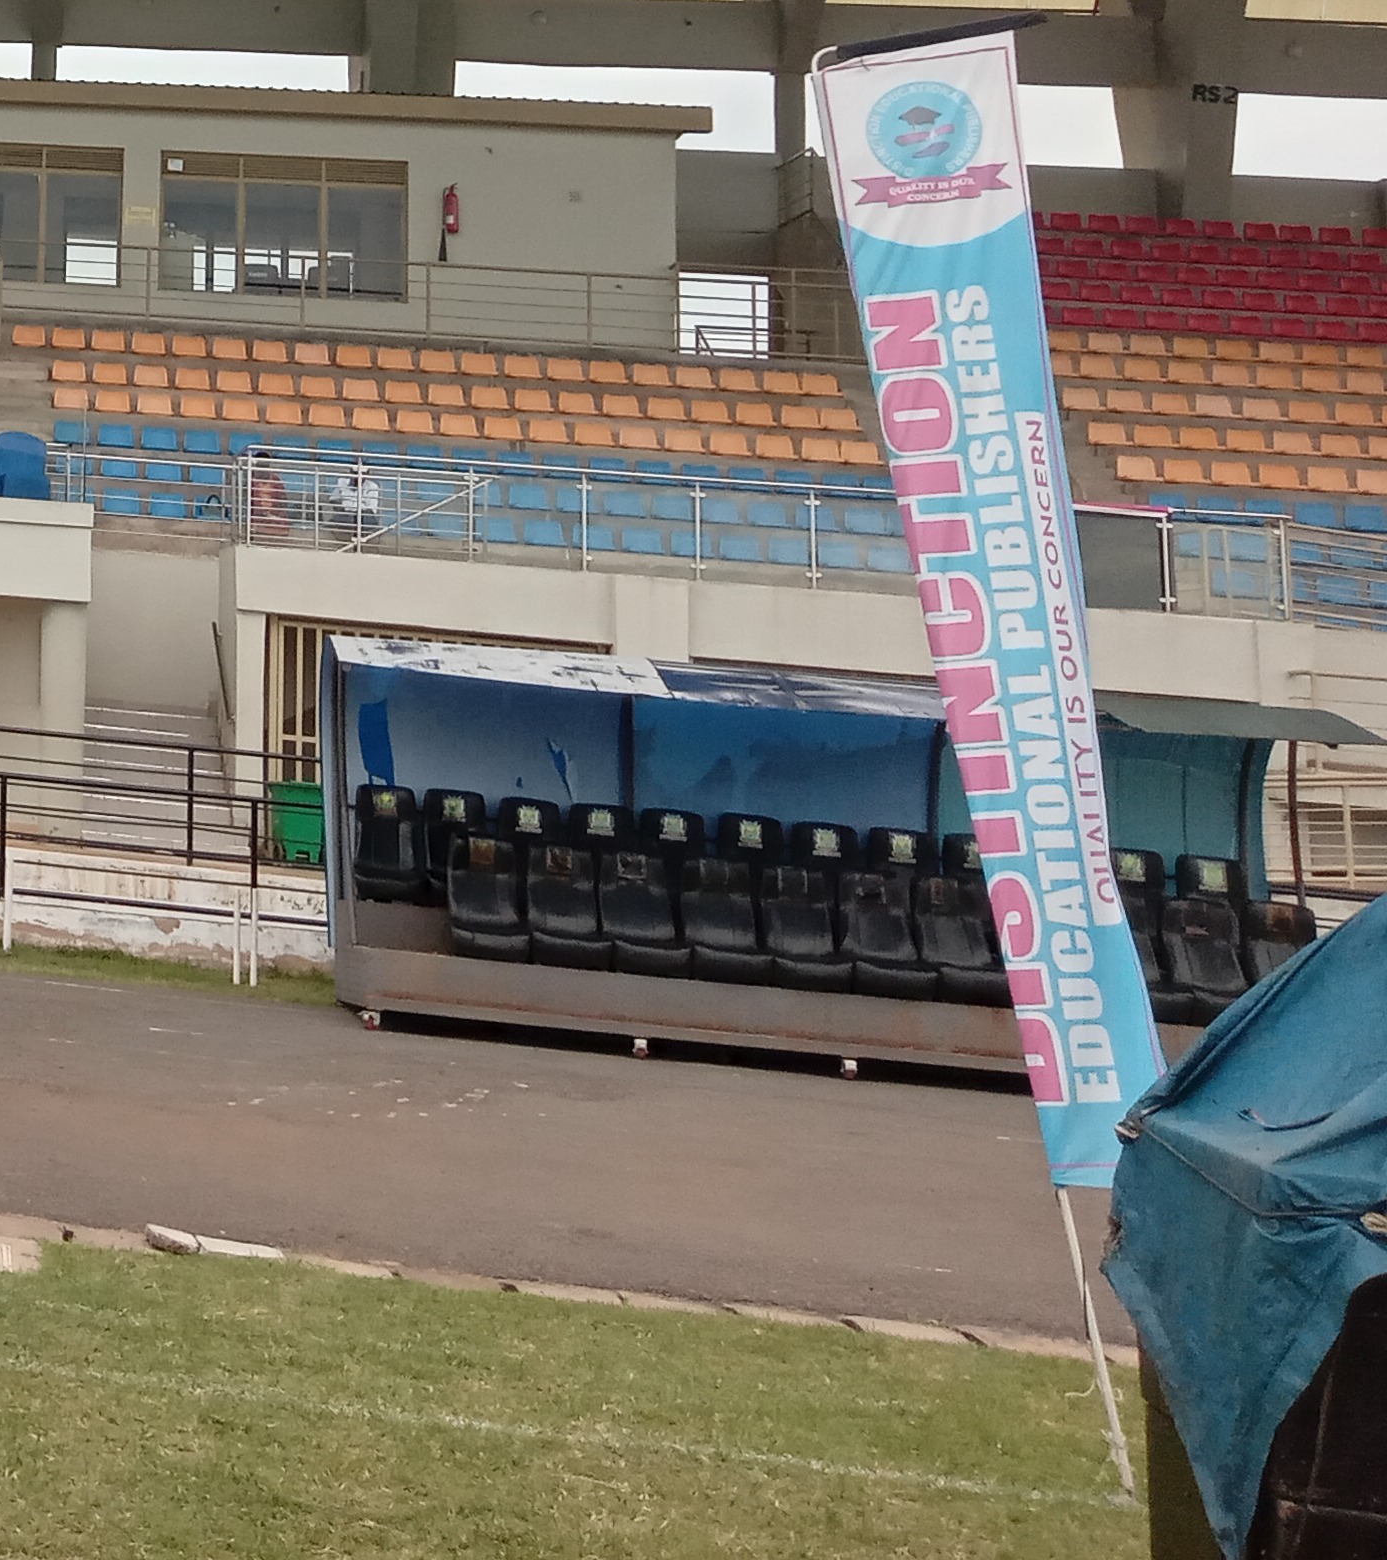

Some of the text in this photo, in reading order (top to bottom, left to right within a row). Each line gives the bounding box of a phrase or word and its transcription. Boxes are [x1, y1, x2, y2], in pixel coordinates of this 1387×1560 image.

[1192, 84, 1239, 104] RS2
[889, 178, 975, 196] QUALITY IS OUR
[907, 190, 960, 201] CONCERN
[1026, 420, 1064, 589] CONCERN
[1053, 604, 1078, 680] OUR
[946, 285, 1121, 1103] EDUCATIONAL PUBLISHERS
[1067, 695, 1088, 725] IS
